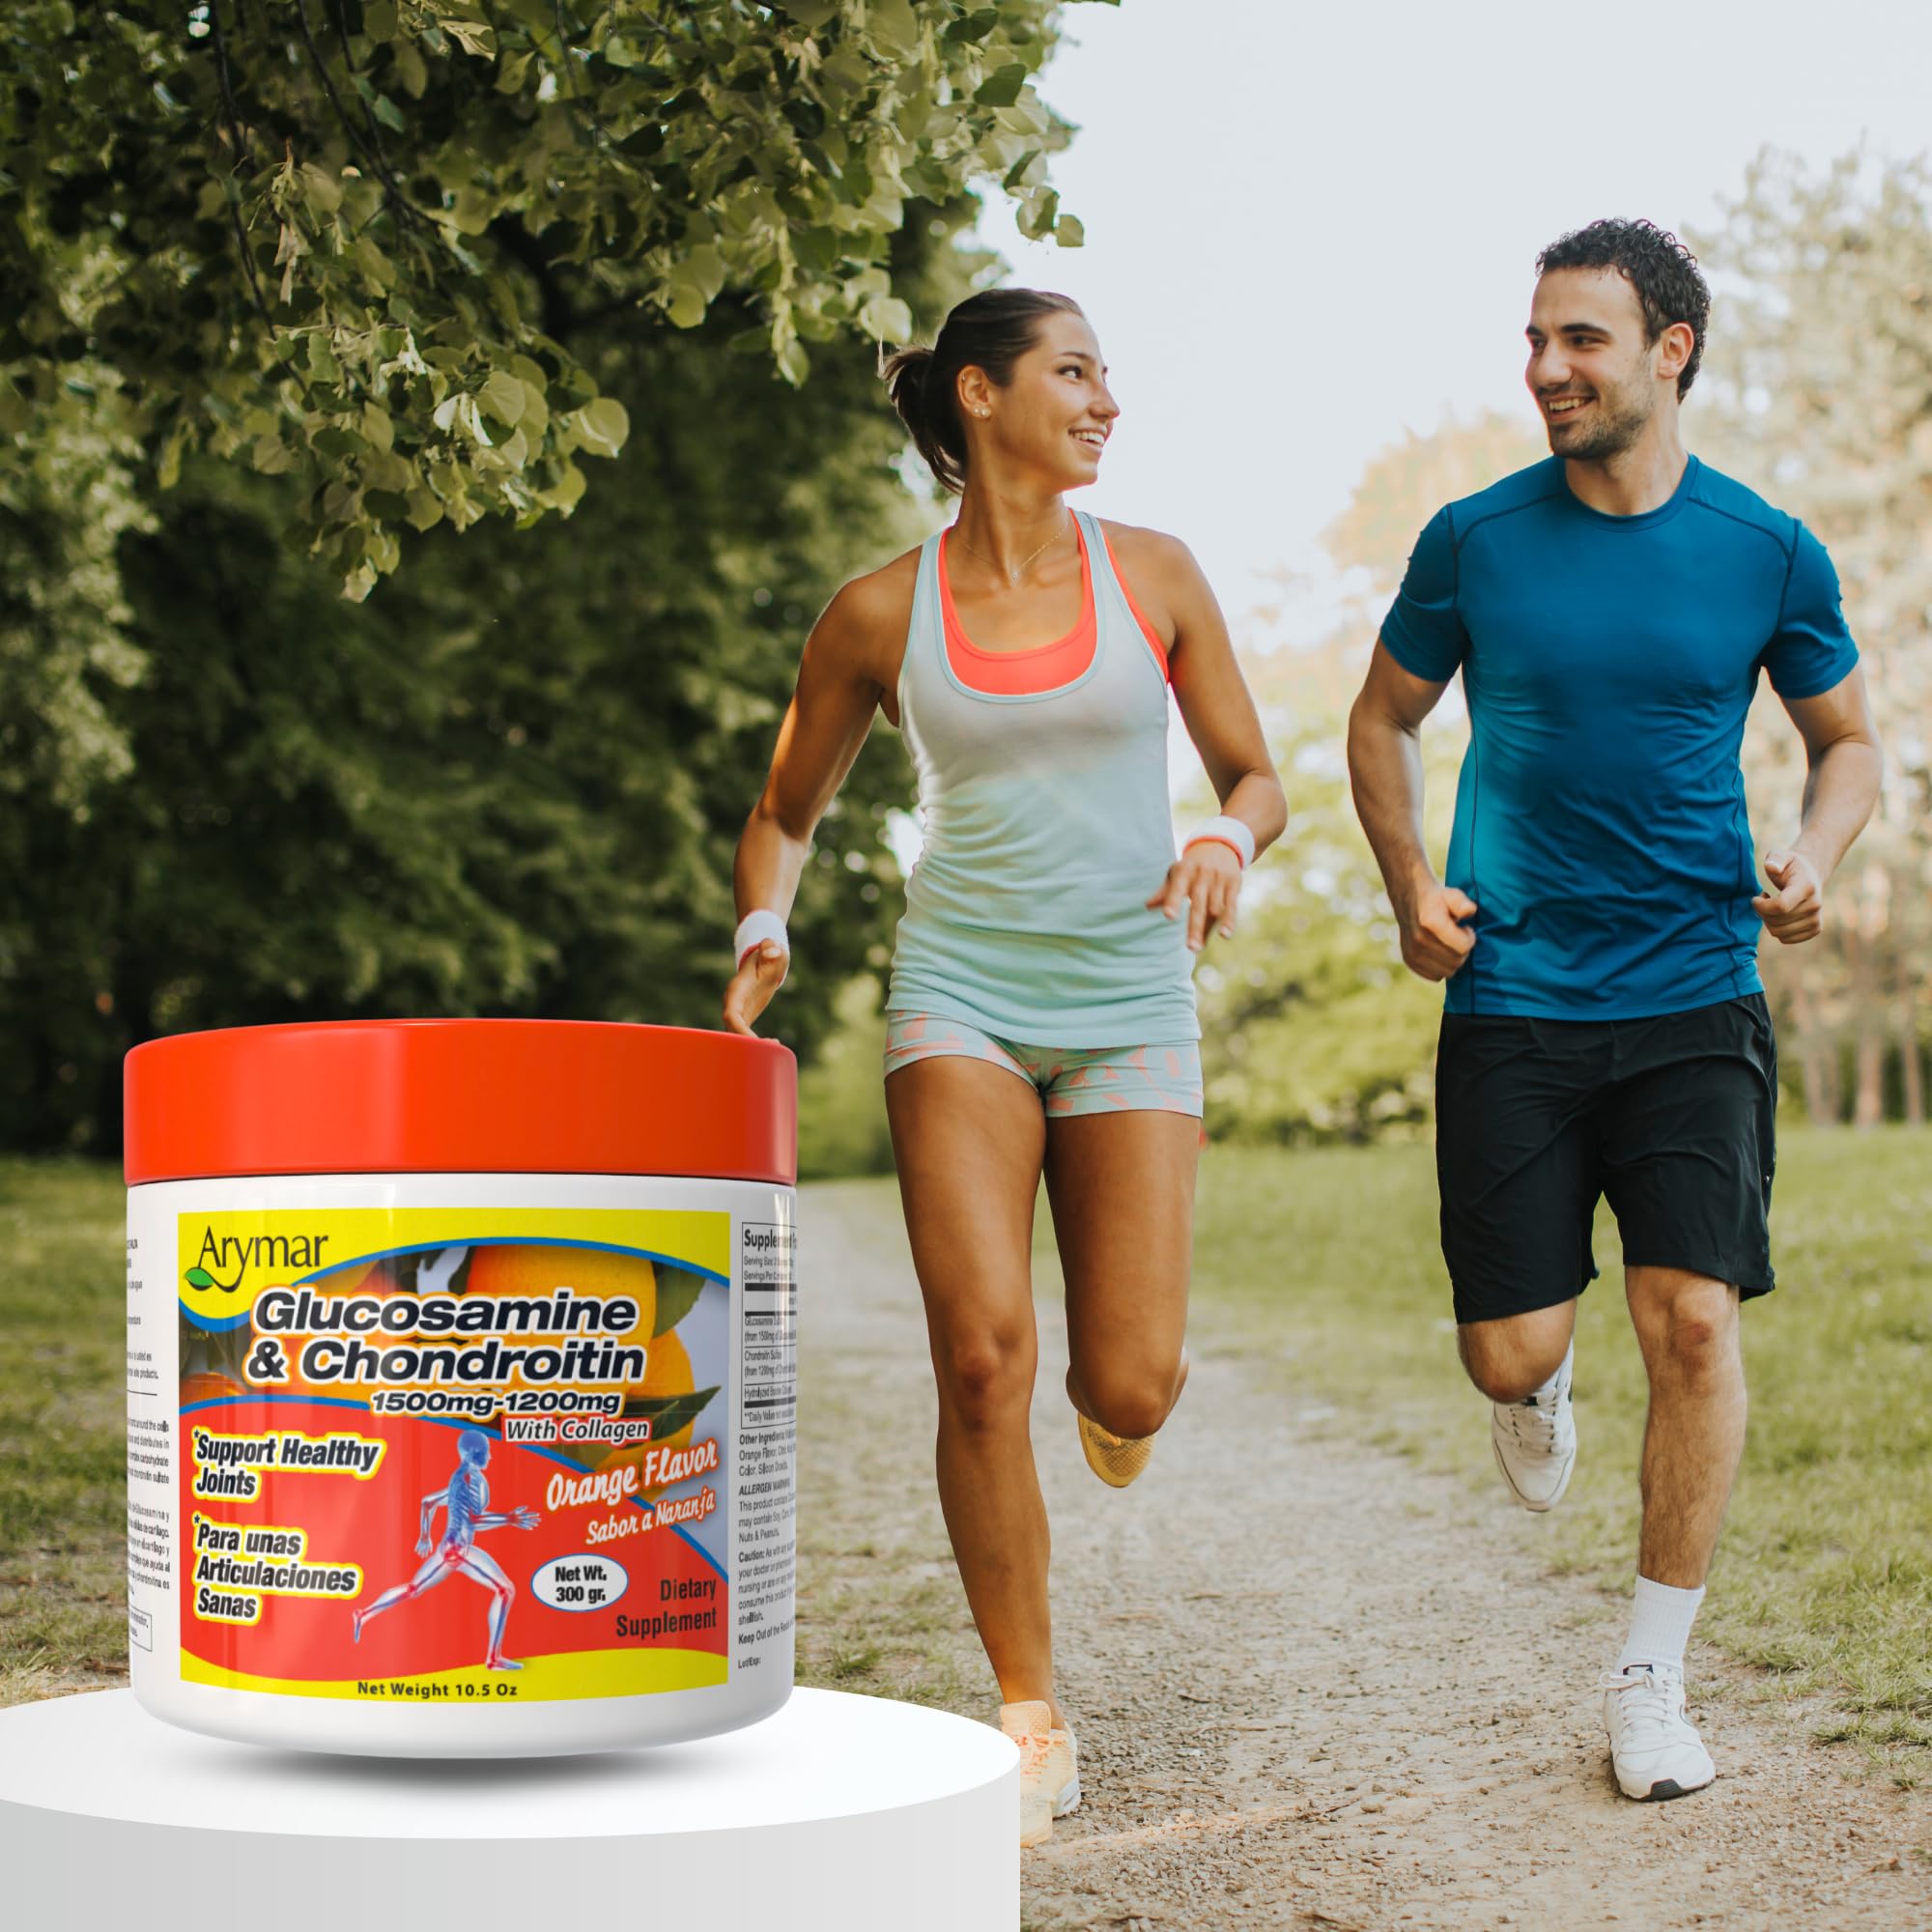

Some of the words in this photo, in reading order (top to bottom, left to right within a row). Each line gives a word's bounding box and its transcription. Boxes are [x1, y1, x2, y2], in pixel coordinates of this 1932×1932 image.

[197, 1225, 329, 1293] Arymar
[254, 1291, 638, 1332] Glucosamine
[247, 1340, 286, 1379] &
[302, 1340, 644, 1379] Chondroitin
[372, 1392, 621, 1415] 1500mg-1200mg
[507, 1420, 555, 1440] With
[561, 1420, 648, 1442] Collagen
[739, 1434, 757, 1445] Other
[280, 1438, 380, 1472] Healthy
[739, 1450, 761, 1463] Orange
[195, 1467, 257, 1495] Joints
[546, 1465, 639, 1511] Orange
[644, 1440, 718, 1486] Flavor
[739, 1482, 772, 1496] ALLERGEN
[585, 1515, 639, 1546] Sabor
[641, 1512, 653, 1532] a
[655, 1486, 716, 1527] Naranja
[739, 1500, 753, 1512] This
[245, 1532, 302, 1555] unas
[196, 1555, 356, 1592] Articulaciones
[554, 1566, 582, 1582] Net
[583, 1565, 608, 1582] Wt.
[555, 1586, 584, 1603] 300
[588, 1588, 607, 1605] gr.
[660, 1577, 717, 1602] Dietary
[197, 1587, 258, 1618] Sanas
[616, 1607, 717, 1639] Supplement
[739, 1633, 754, 1645] Keep
[357, 1682, 385, 1695] Net
[390, 1683, 449, 1699] Weight
[455, 1684, 491, 1697] 10.5
[497, 1684, 518, 1697] Oz
